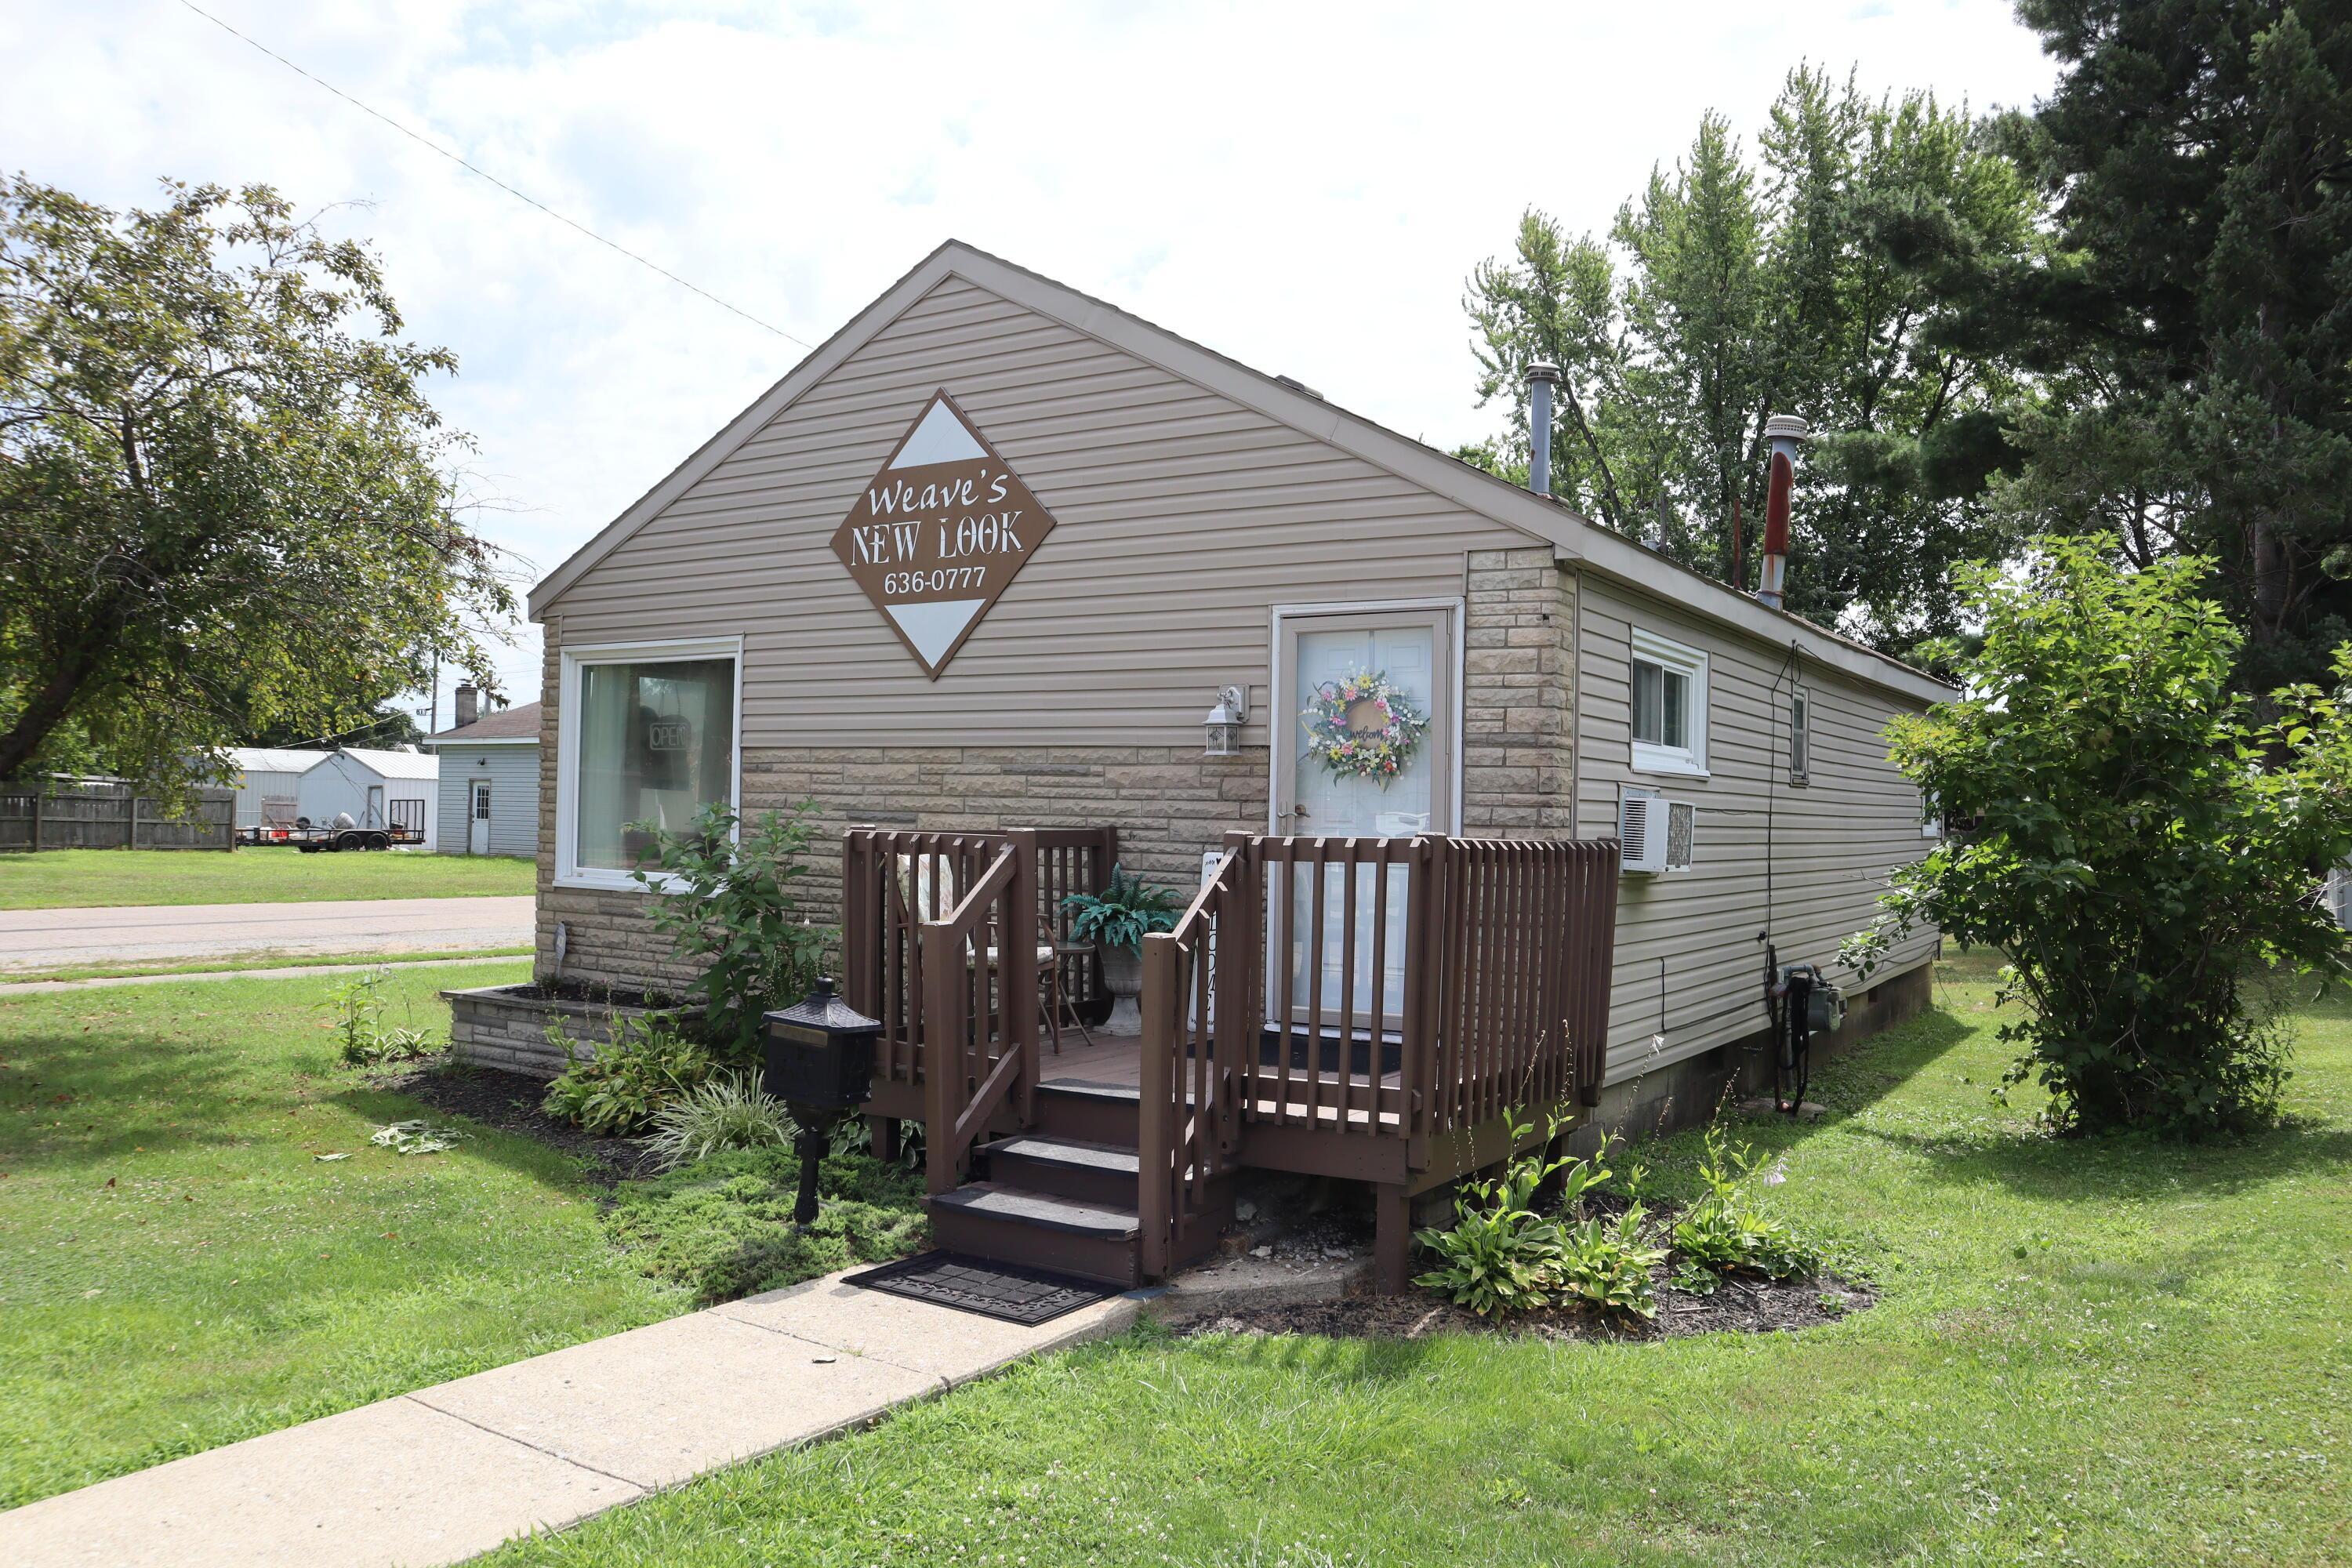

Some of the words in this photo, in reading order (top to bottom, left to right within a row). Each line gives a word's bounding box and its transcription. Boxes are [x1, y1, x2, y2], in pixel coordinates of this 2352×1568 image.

[869, 469, 1008, 515] Weave's
[851, 521, 921, 566] NEW
[938, 510, 1024, 559] LOOK
[884, 566, 986, 594] 636-0777
[652, 727, 685, 746] OPEN
[1350, 725, 1383, 742] welcom
